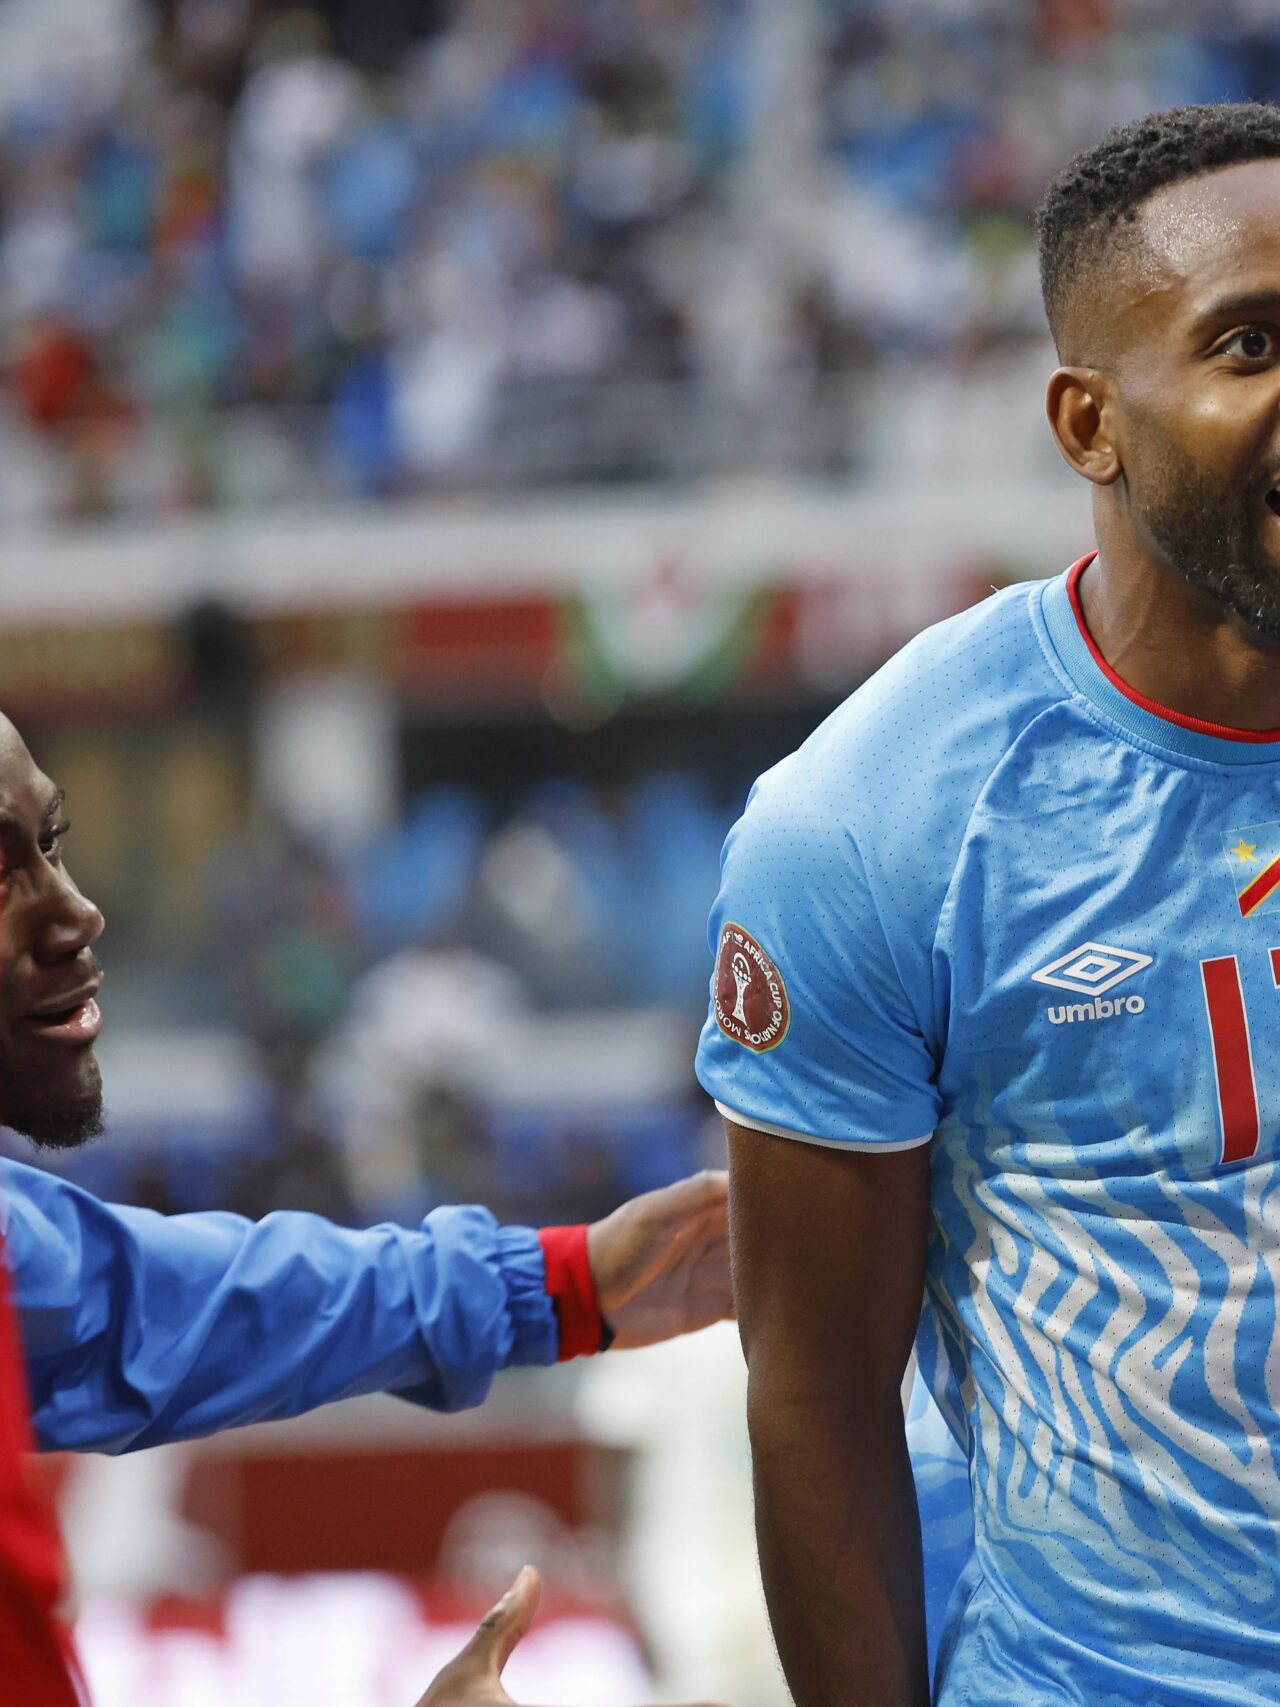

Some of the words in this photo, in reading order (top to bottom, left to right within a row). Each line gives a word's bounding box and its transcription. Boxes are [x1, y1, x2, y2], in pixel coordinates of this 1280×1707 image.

[743, 940, 773, 981] AFRICA
[770, 981, 783, 1009] CUP
[771, 1010, 783, 1029] OF
[1047, 994, 1145, 1025] umbro
[744, 1023, 779, 1045] NATIONS
